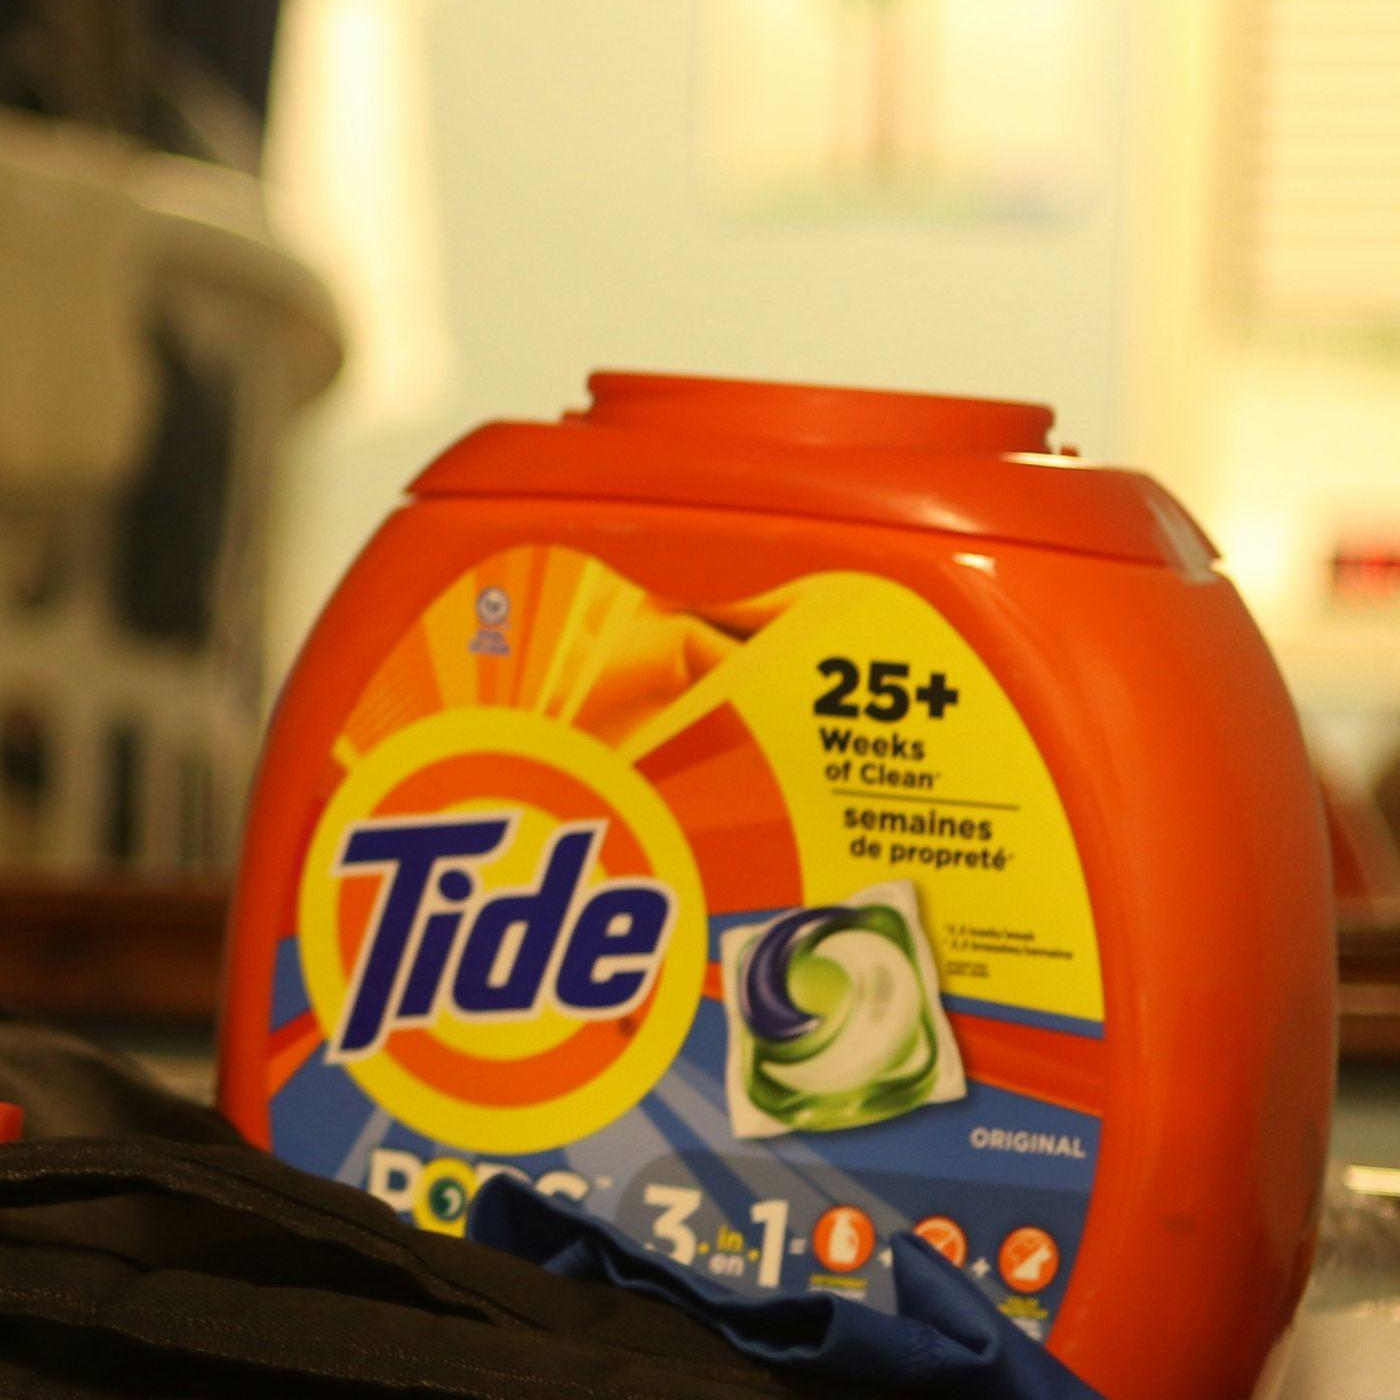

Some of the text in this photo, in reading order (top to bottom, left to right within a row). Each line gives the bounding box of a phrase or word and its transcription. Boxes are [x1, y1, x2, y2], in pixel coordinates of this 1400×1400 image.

[813, 657, 959, 722] 25+
[819, 727, 925, 761] Weeks
[825, 760, 852, 781] of
[844, 806, 993, 841] semaines
[850, 836, 882, 859] de
[332, 814, 674, 1059] Tide
[969, 1126, 1087, 1159] ORIGINAL
[368, 1148, 590, 1240] PO
[643, 1183, 790, 1288] 3 in 1
